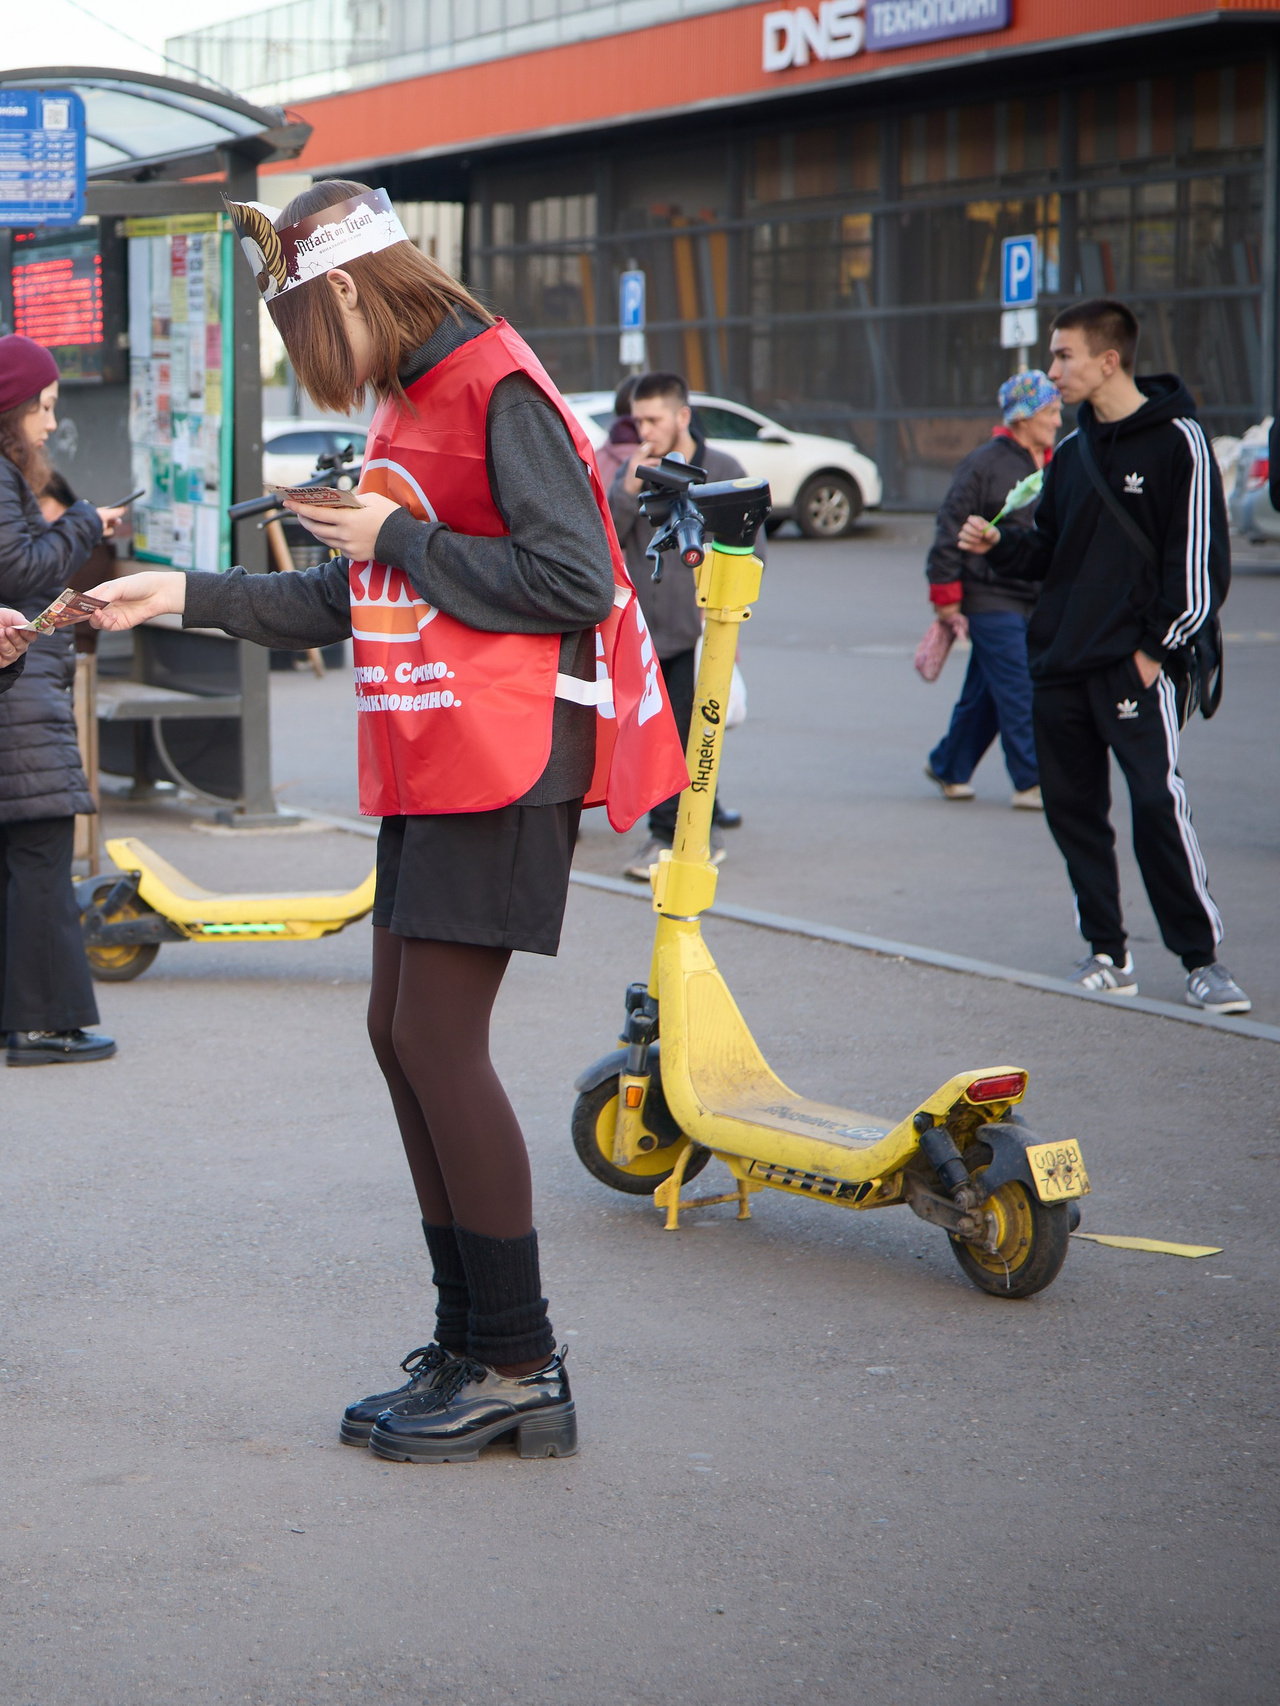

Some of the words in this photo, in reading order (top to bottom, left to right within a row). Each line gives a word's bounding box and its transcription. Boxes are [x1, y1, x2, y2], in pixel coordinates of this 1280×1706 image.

[762, 0, 865, 72] DNS
[295, 229, 335, 256] Attack
[335, 227, 345, 237] on
[342, 214, 373, 234] Titan
[1010, 245, 1030, 299] P
[625, 280, 641, 322] P
[394, 661, 455, 684] Сочно.
[701, 699, 721, 725] Go
[691, 729, 716, 793] Яндекс
